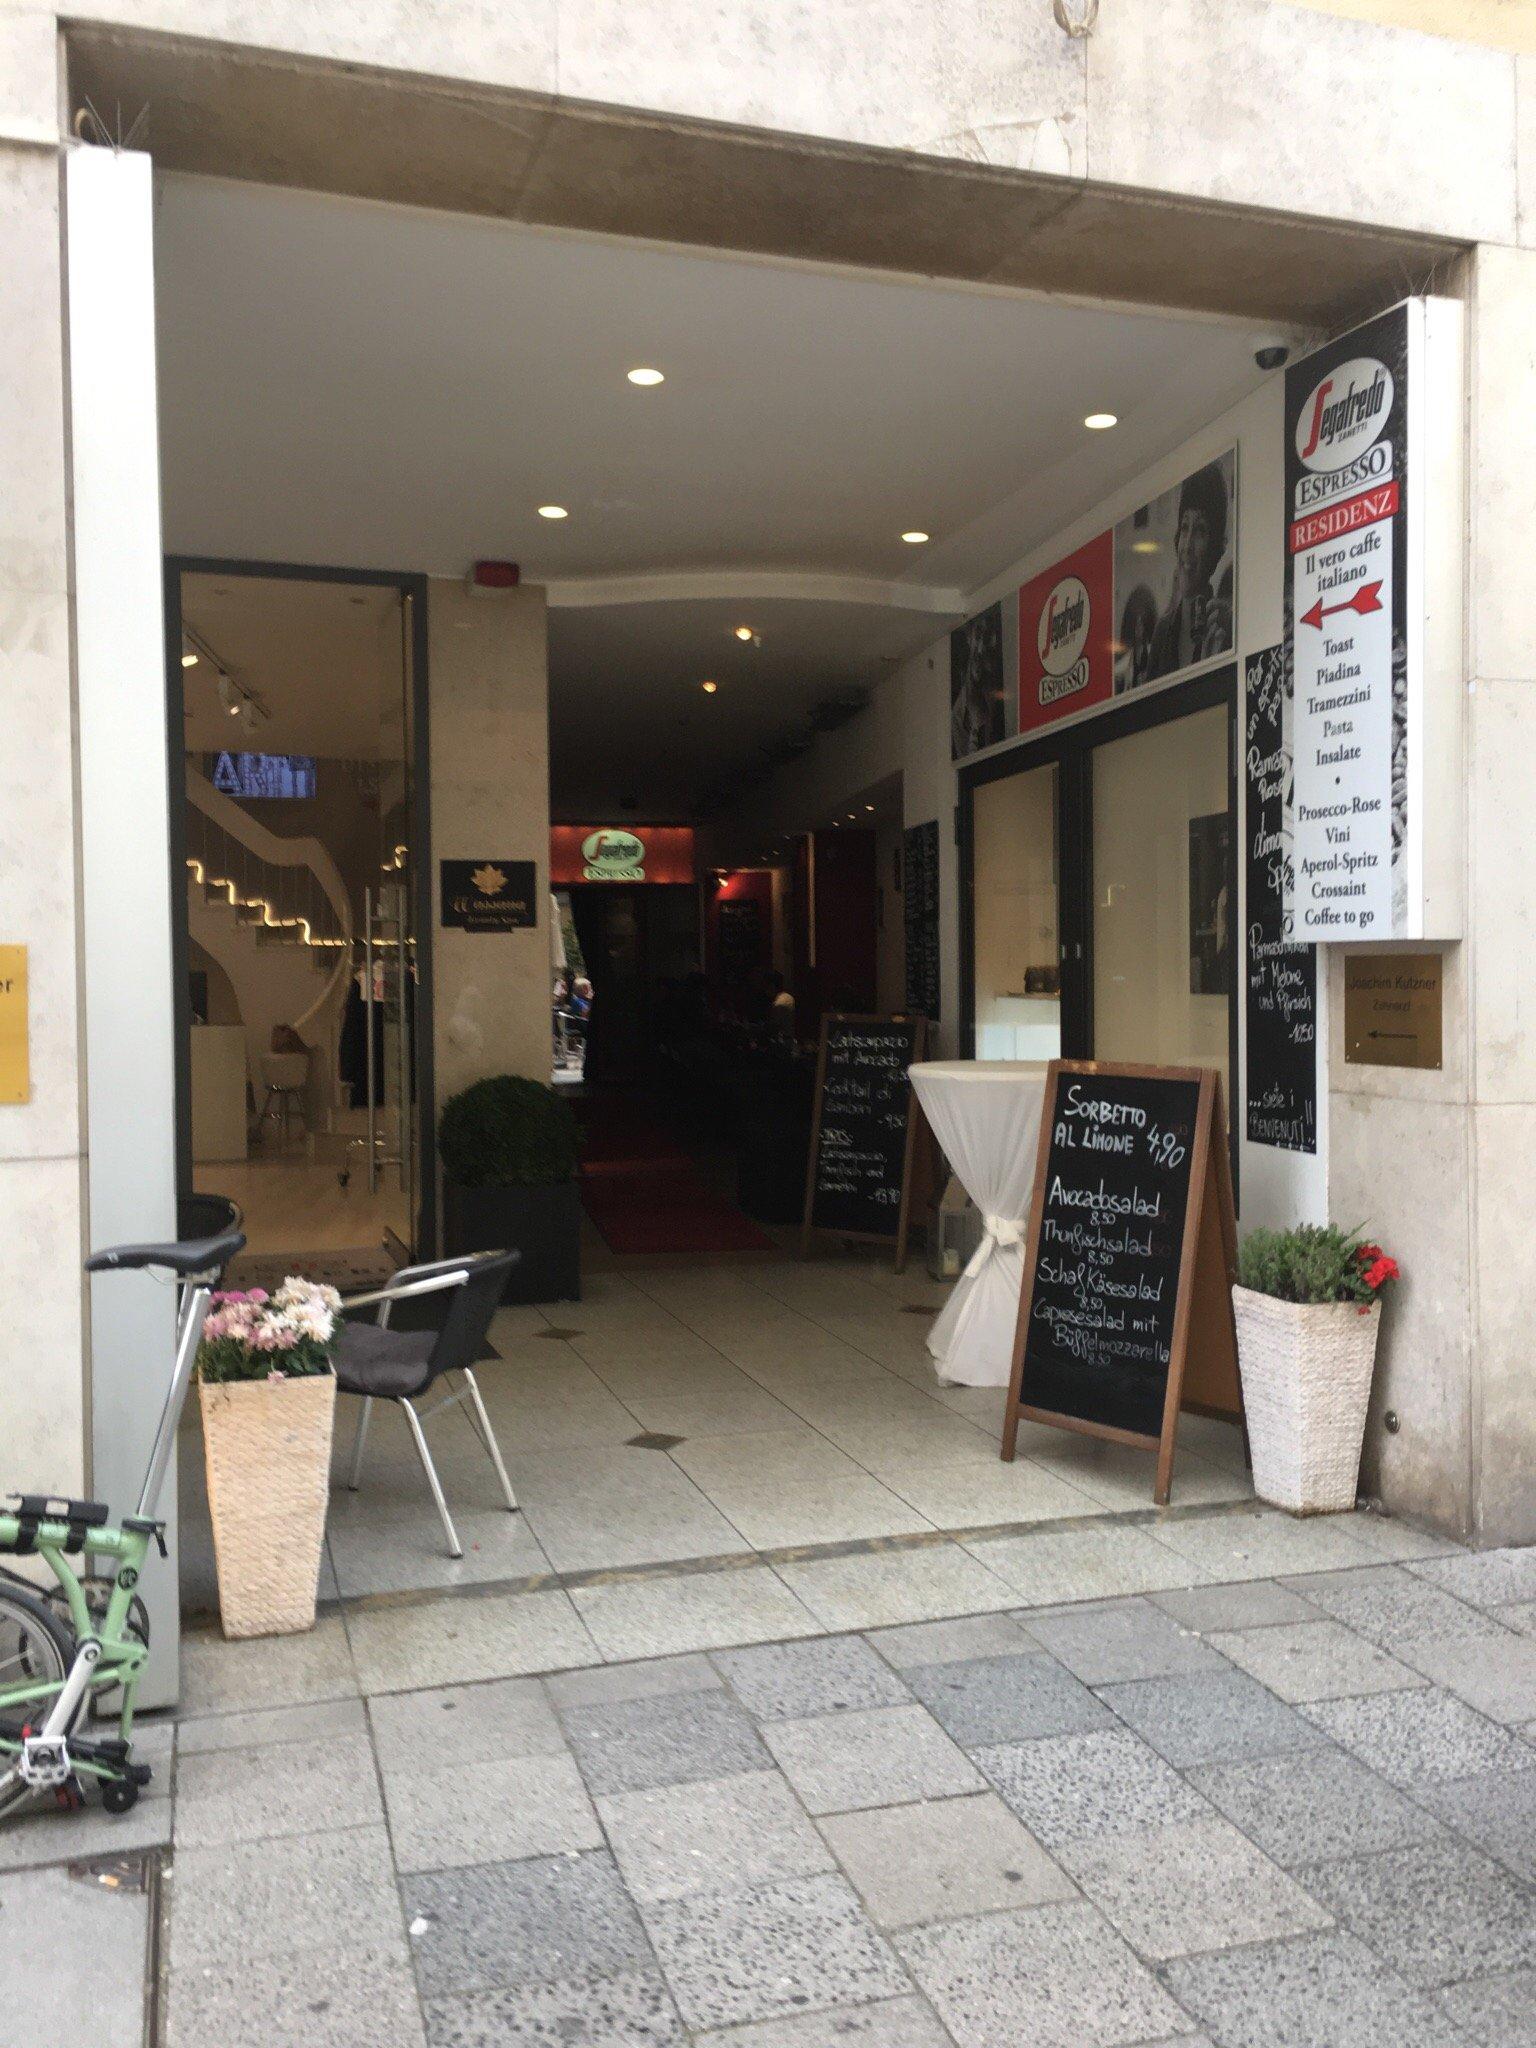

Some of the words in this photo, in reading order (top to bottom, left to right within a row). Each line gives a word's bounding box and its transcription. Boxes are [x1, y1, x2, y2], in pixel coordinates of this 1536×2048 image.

[1302, 369, 1386, 460] Segafredo
[1300, 447, 1386, 506] ESPRESSO
[1294, 489, 1392, 547] RESIDENZ
[1305, 555, 1315, 575] Il
[1319, 549, 1346, 570] vero
[1349, 530, 1382, 559] caffe
[1317, 563, 1368, 593] italiano
[1323, 637, 1354, 657] Toast
[1042, 661, 1086, 701] ESPRESSO
[1316, 662, 1362, 687] Piadina
[1307, 684, 1371, 715] Tramezzini
[1323, 720, 1354, 738] Pasta
[1315, 744, 1361, 767] Insalate
[1298, 796, 1381, 822] Prosecco-Rose
[1325, 826, 1351, 844] Vini
[1300, 851, 1378, 878] Aperol-Spritz
[1311, 880, 1367, 899] Crossaint
[1304, 906, 1341, 926] Coffee
[1344, 910, 1356, 923] to
[1359, 913, 1374, 929] go
[1251, 961, 1267, 988] mit
[1259, 990, 1274, 1011] und
[1064, 1085, 1146, 1129] SORBETTO
[1055, 1122, 1077, 1149] AL
[1147, 1123, 1186, 1169] 4,90
[1048, 1175, 1161, 1217] Avocadosalad
[1090, 1211, 1116, 1226] 8,50
[1043, 1219, 1152, 1257] Thunfischsalad
[1087, 1250, 1114, 1265] 8,50
[1033, 1298, 1125, 1331] Capresesalad
[1133, 1315, 1160, 1333] mit
